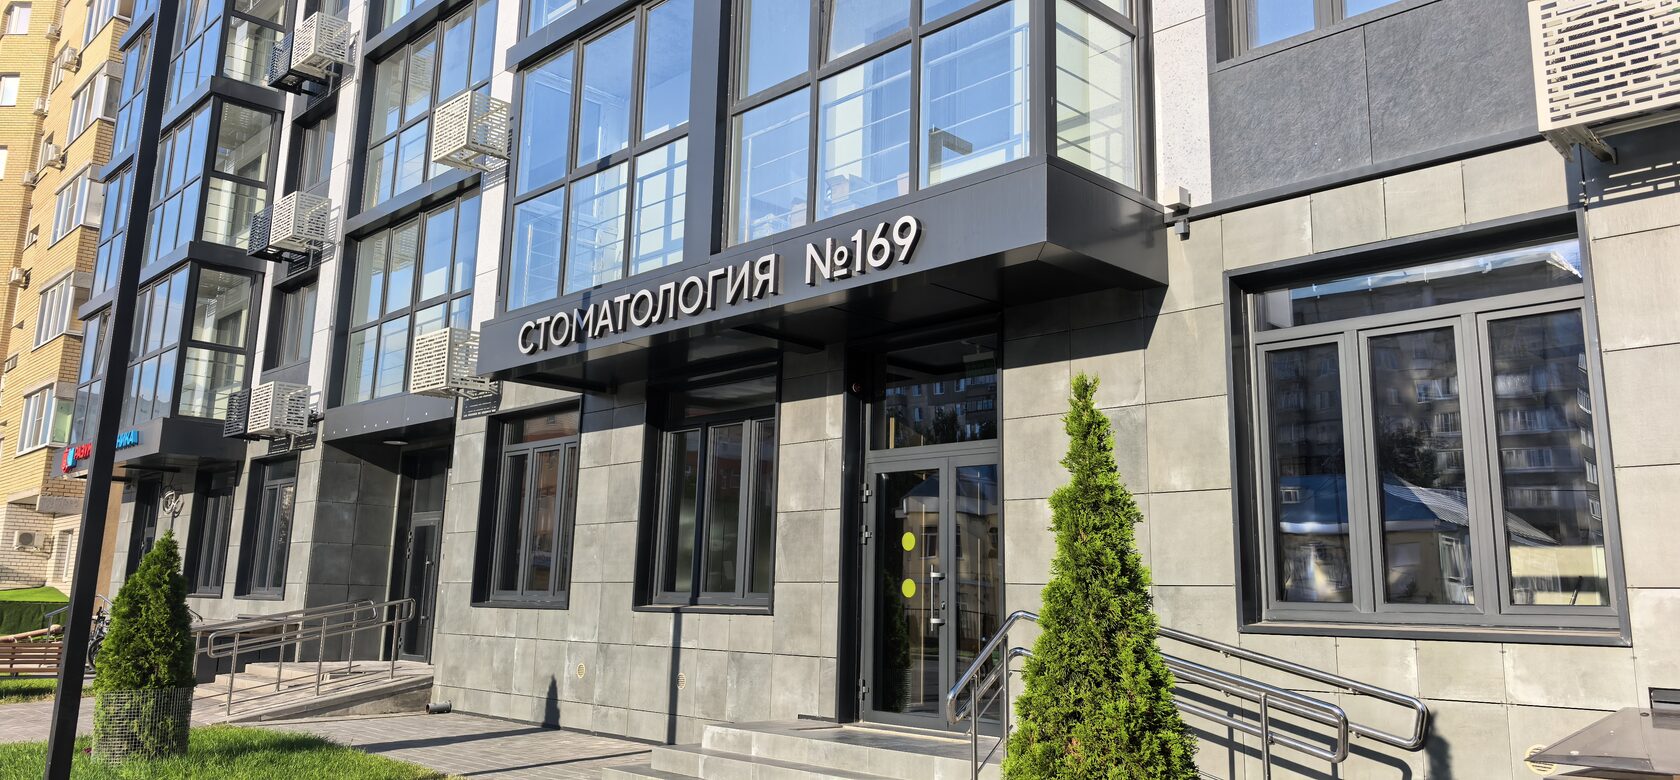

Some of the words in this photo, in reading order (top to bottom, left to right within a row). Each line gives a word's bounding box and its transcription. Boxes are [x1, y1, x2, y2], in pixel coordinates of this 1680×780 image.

[518, 253, 781, 355] СТОМАТОЛОГИЯ
[805, 215, 922, 286] №169
[115, 430, 137, 448] НИКА
